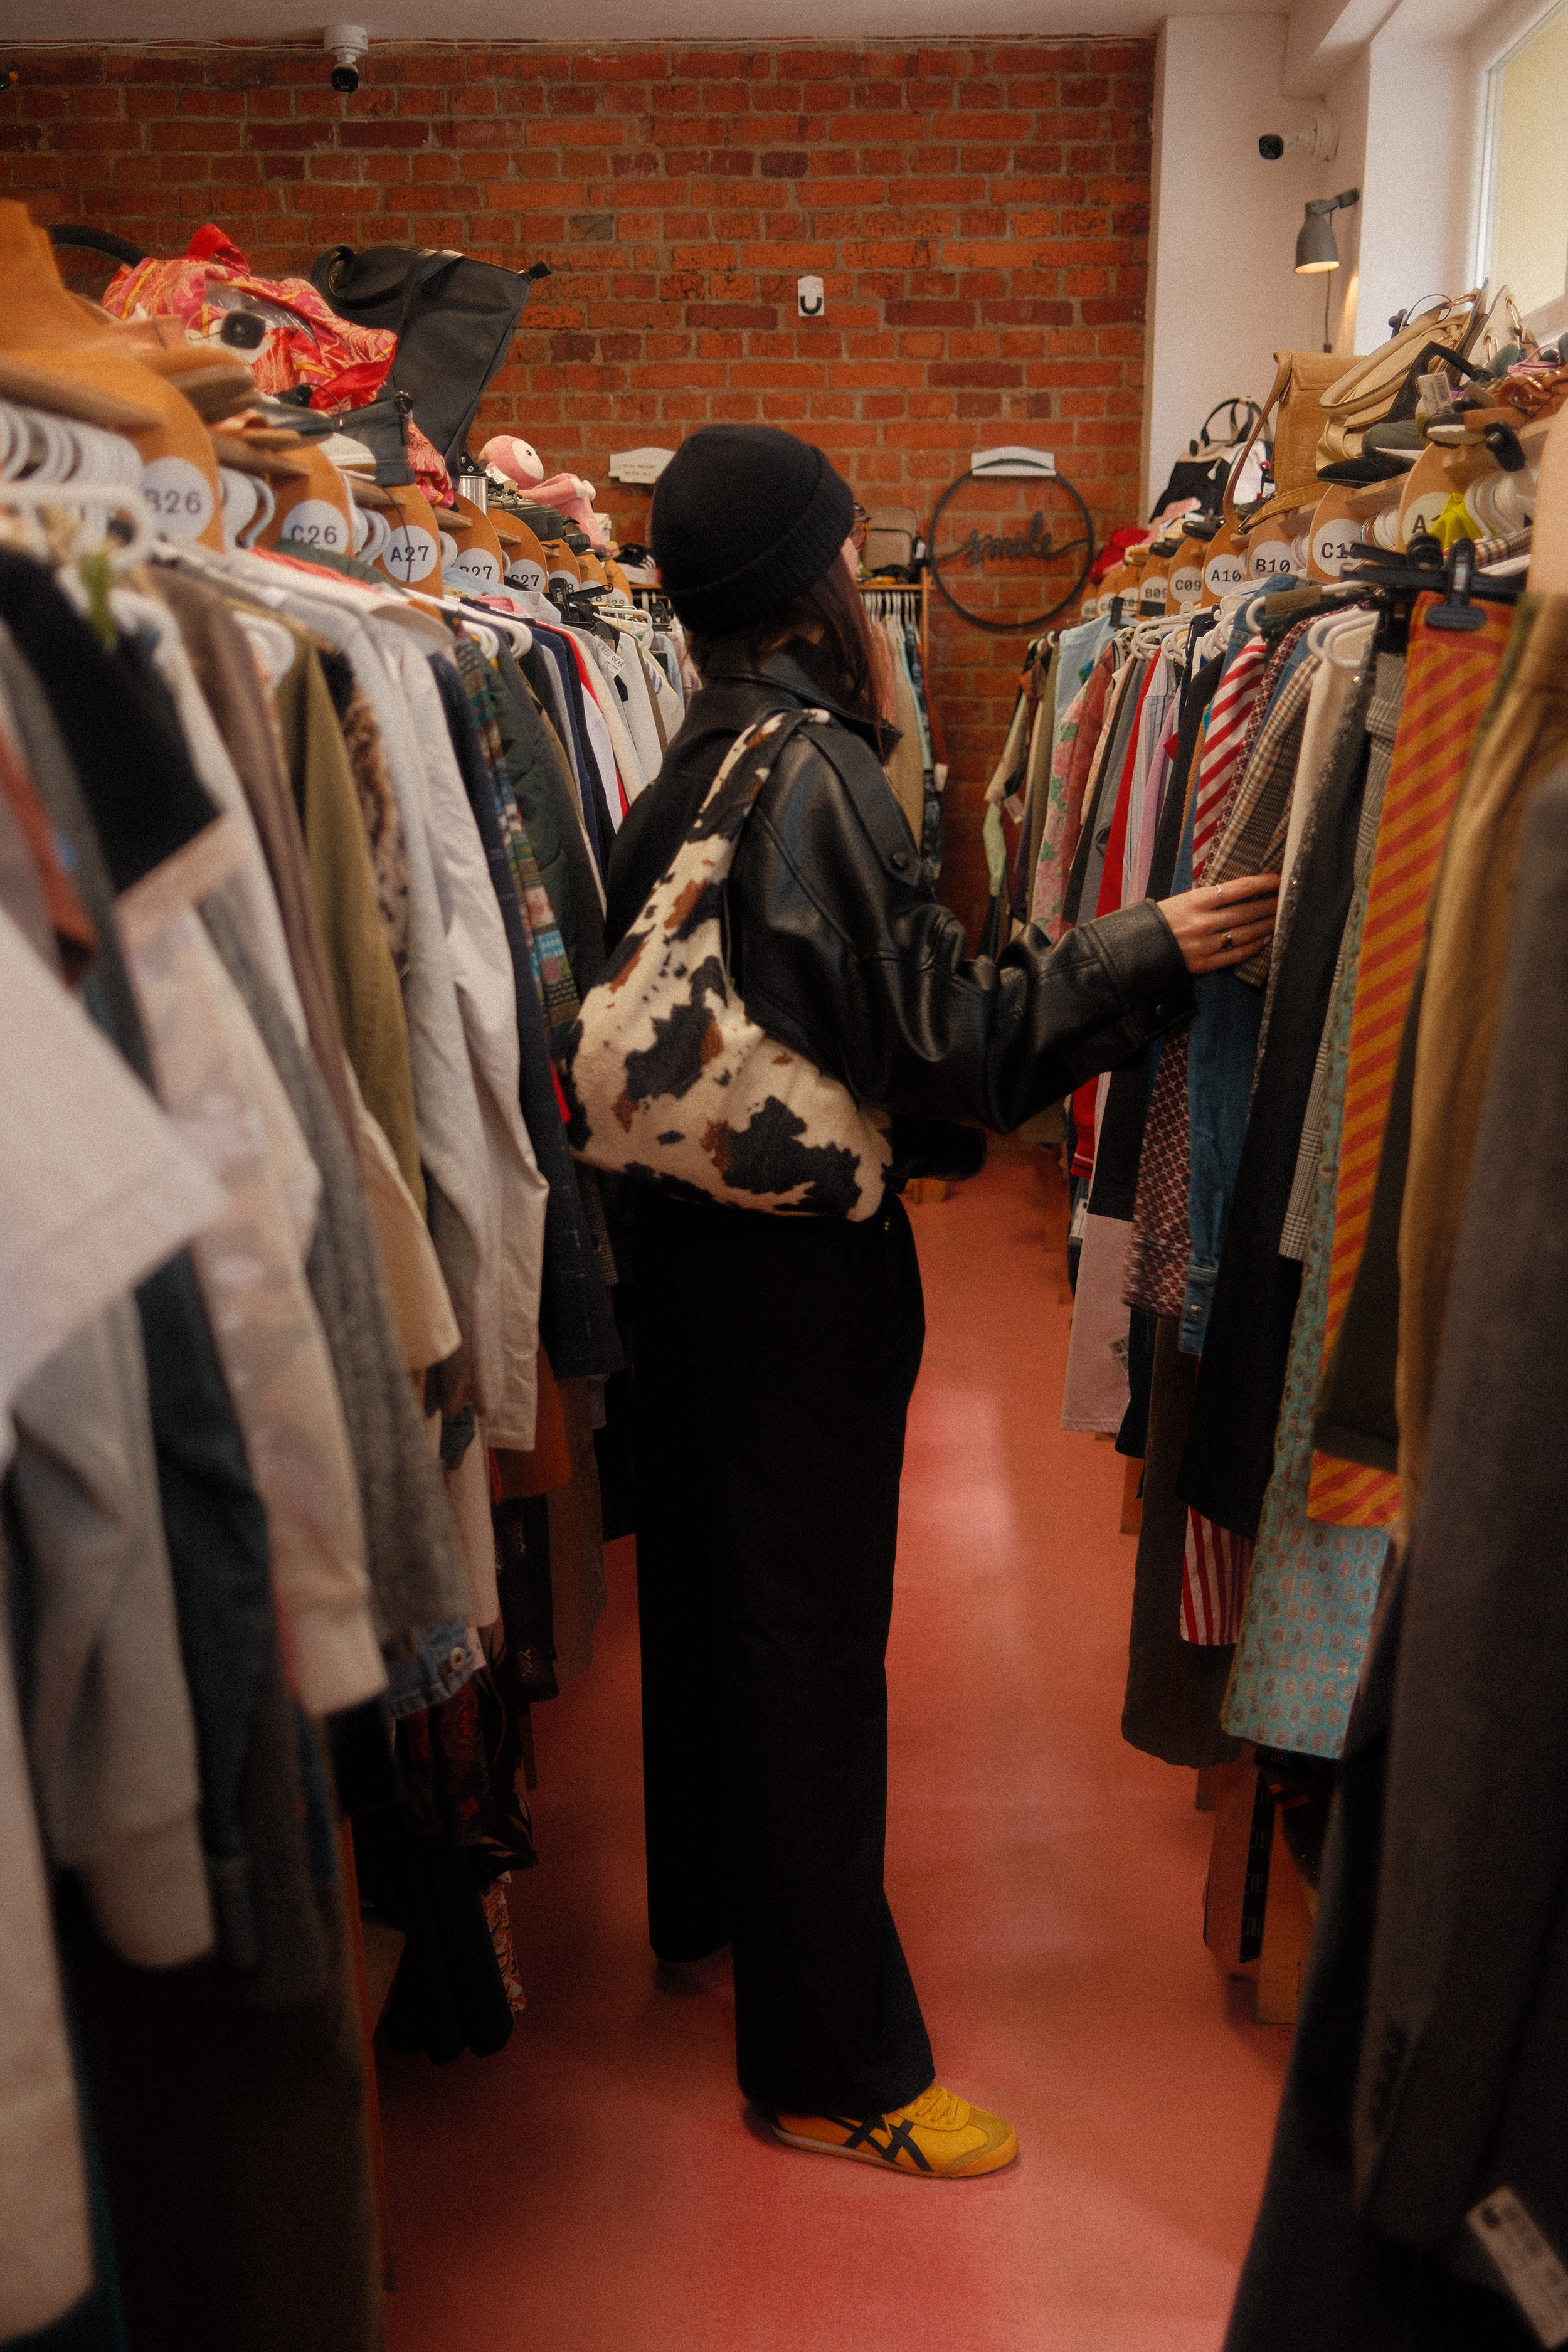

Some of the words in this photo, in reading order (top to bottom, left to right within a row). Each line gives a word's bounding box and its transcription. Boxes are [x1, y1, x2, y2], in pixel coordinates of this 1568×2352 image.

[292, 525, 337, 544] C26
[390, 546, 430, 562] A27
[1321, 542, 1351, 559] C1
[1256, 558, 1290, 573] B10
[1211, 569, 1241, 582] A10
[1175, 580, 1201, 591] C09
